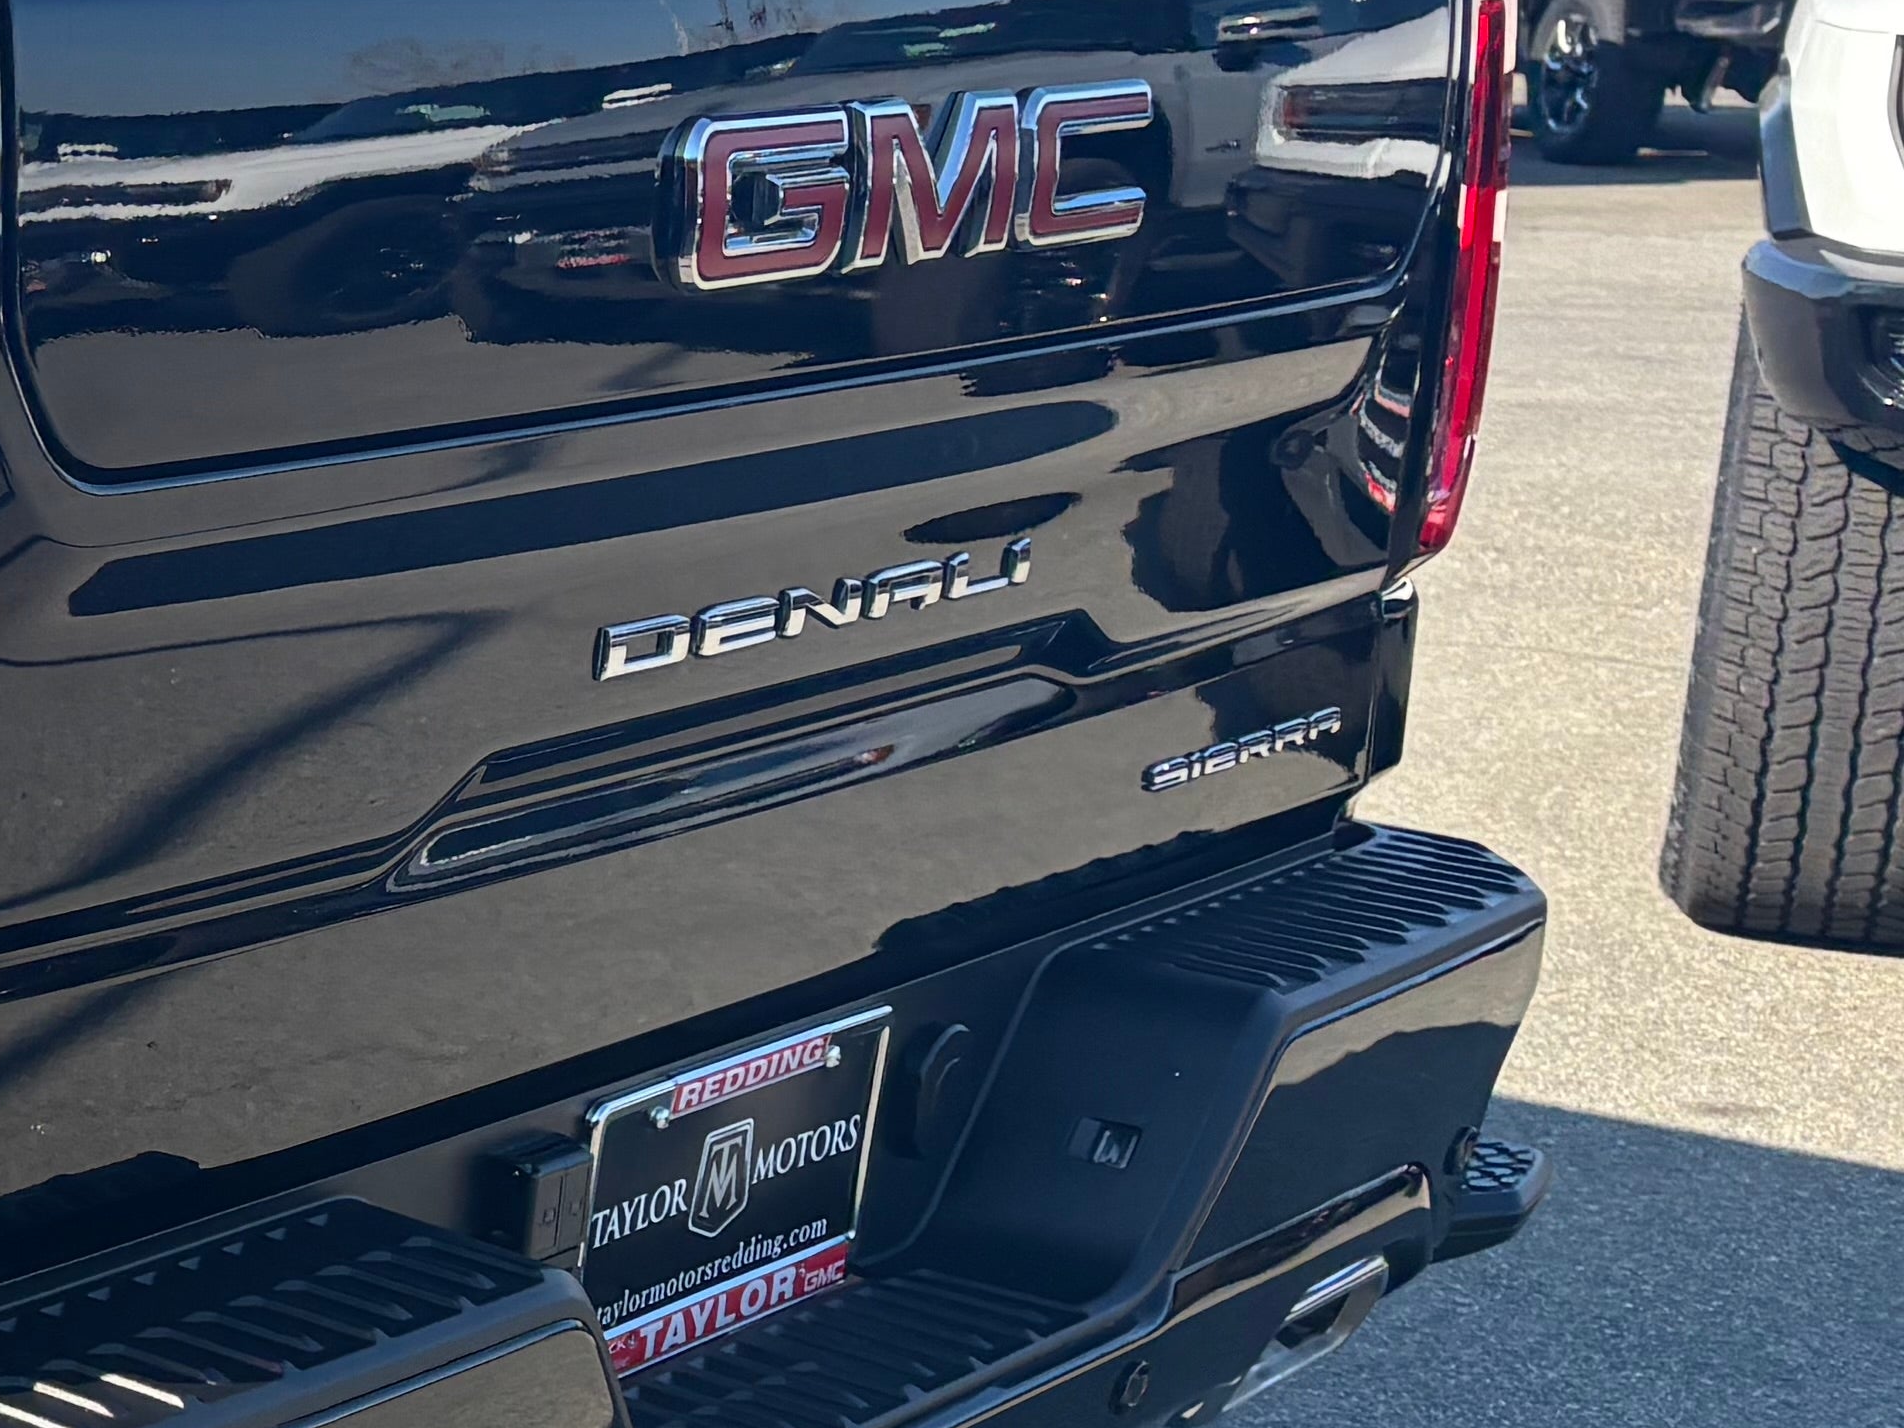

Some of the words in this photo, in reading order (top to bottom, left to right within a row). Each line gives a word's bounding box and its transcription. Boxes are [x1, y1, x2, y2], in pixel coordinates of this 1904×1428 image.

[652, 78, 1154, 292] GMC
[594, 536, 1033, 682] DENALI
[1140, 704, 1342, 792] SIERRA
[677, 1037, 827, 1112] REDDING
[592, 1178, 688, 1249] TAYLOR
[752, 1113, 861, 1184] MOTORS
[597, 1217, 827, 1327] taylormotorsredding.com
[639, 1265, 797, 1361] TAYLOR
[804, 1258, 846, 1293] GMC
